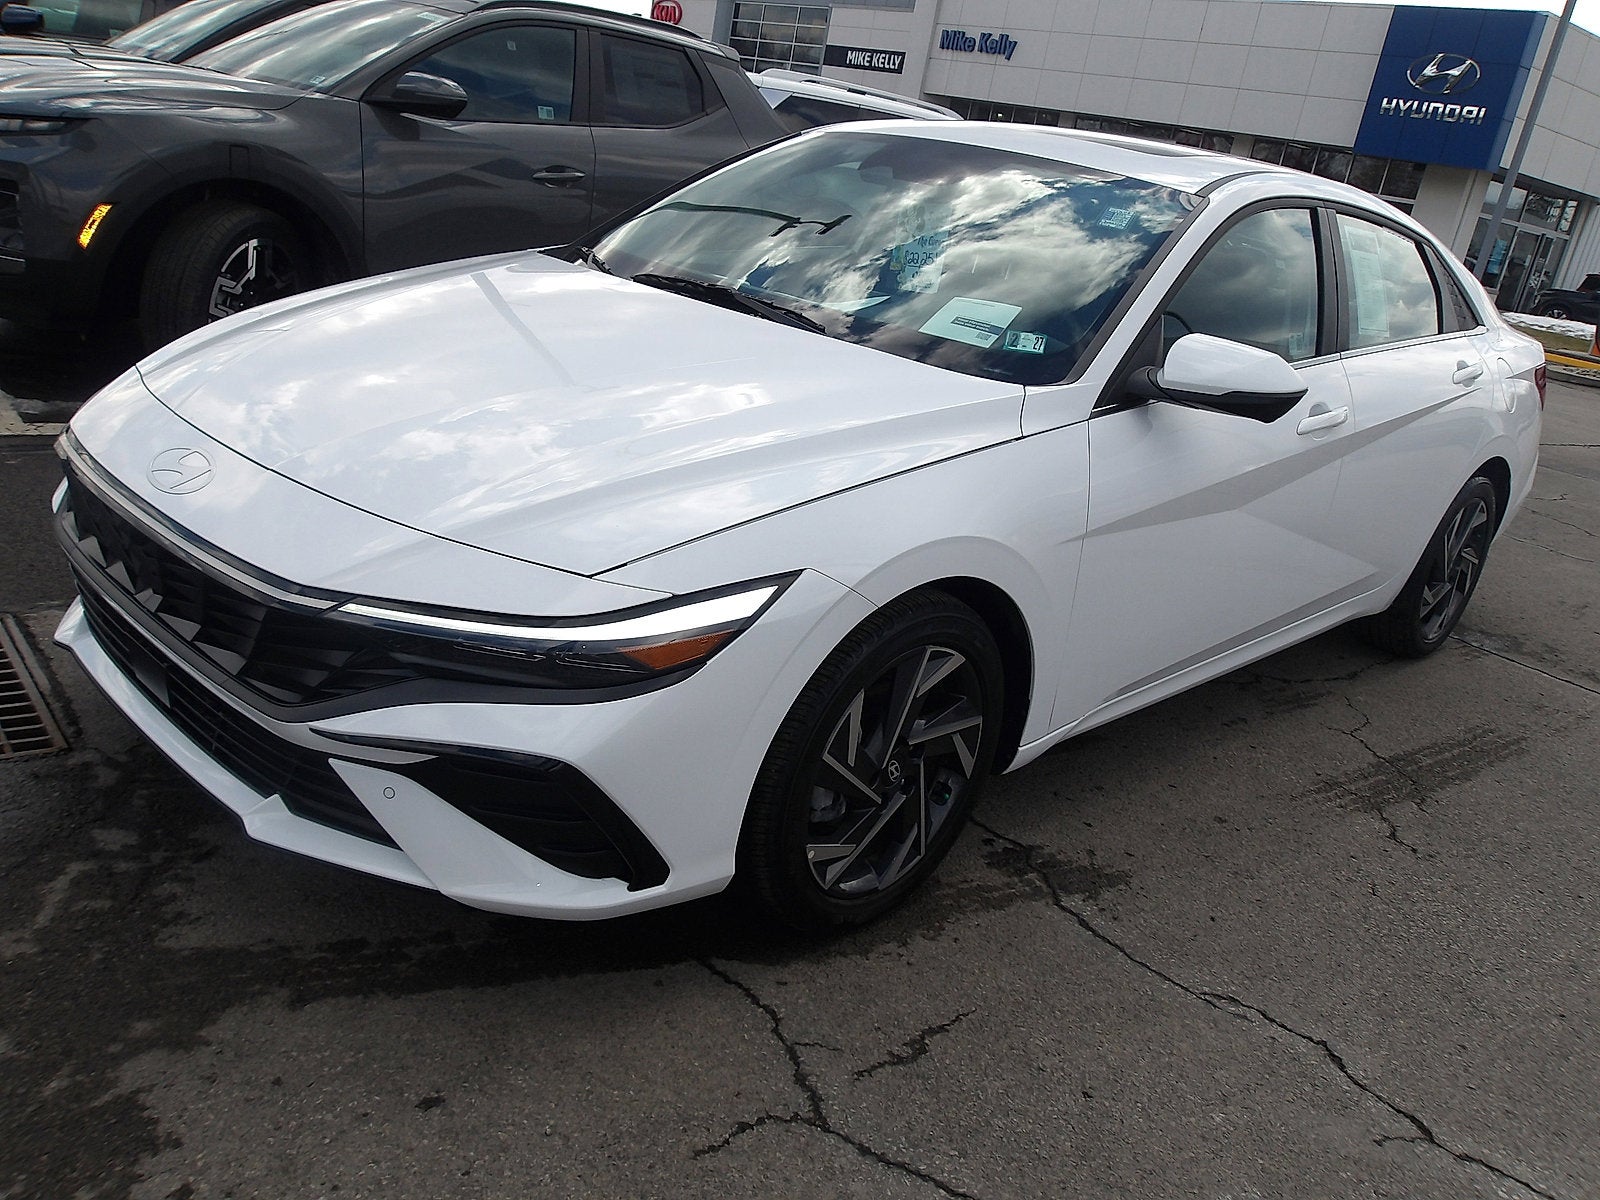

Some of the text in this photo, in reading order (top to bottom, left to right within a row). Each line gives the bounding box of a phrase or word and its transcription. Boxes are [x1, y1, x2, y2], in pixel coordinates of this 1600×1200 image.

[654, 4, 678, 23] KIA
[939, 29, 1018, 61] Mike Kelly
[846, 50, 902, 70] MIKE KELLY
[1379, 97, 1487, 126] HYUNDAI
[1033, 336, 1044, 351] 27
